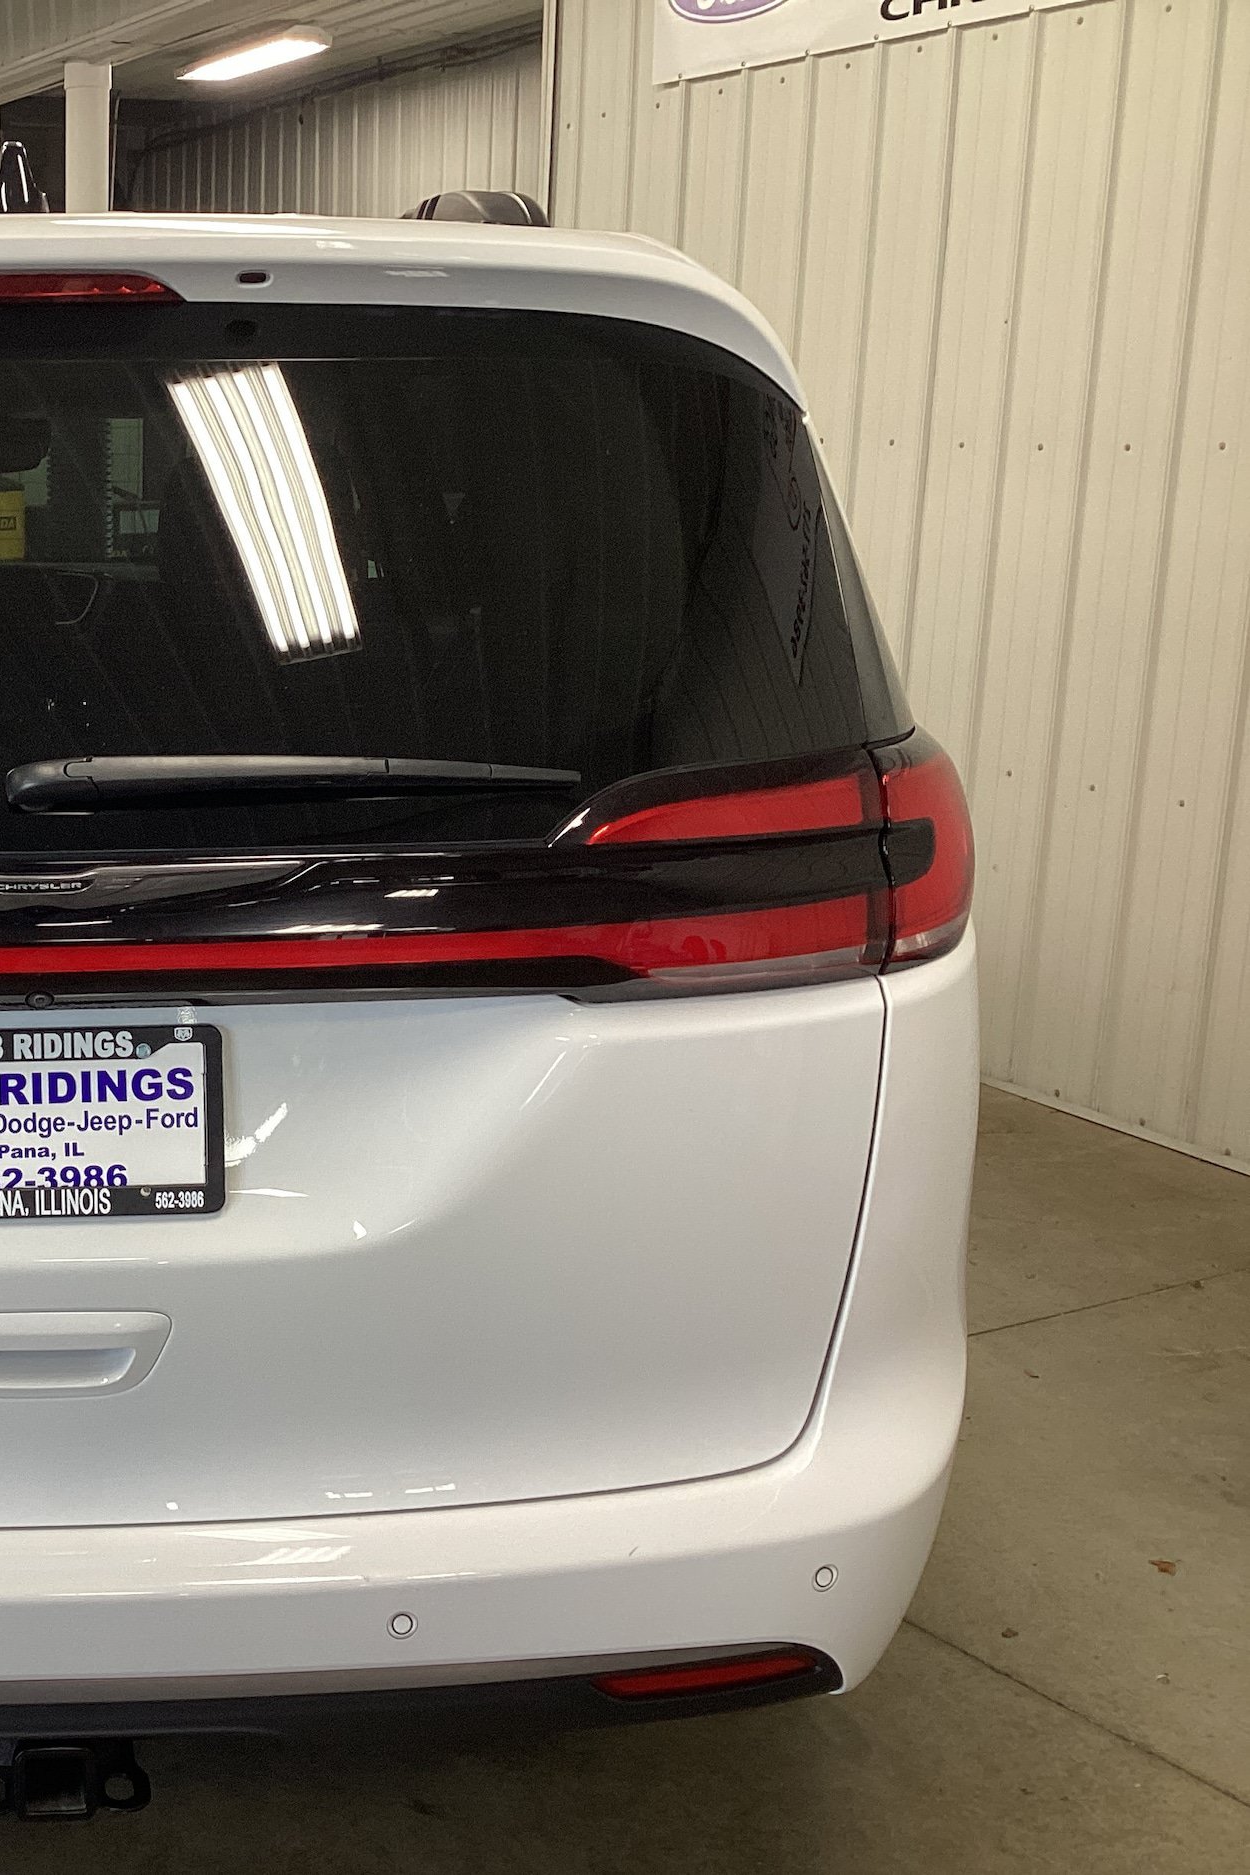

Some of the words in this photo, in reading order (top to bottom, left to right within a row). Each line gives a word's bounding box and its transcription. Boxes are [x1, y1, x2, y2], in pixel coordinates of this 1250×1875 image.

[13, 1030, 134, 1060] RIDINGS
[0, 1067, 195, 1106] RIDINGS
[64, 1142, 85, 1157] IL
[35, 1188, 112, 1215] ILLINOIS
[155, 1191, 205, 1209] 562-3986
